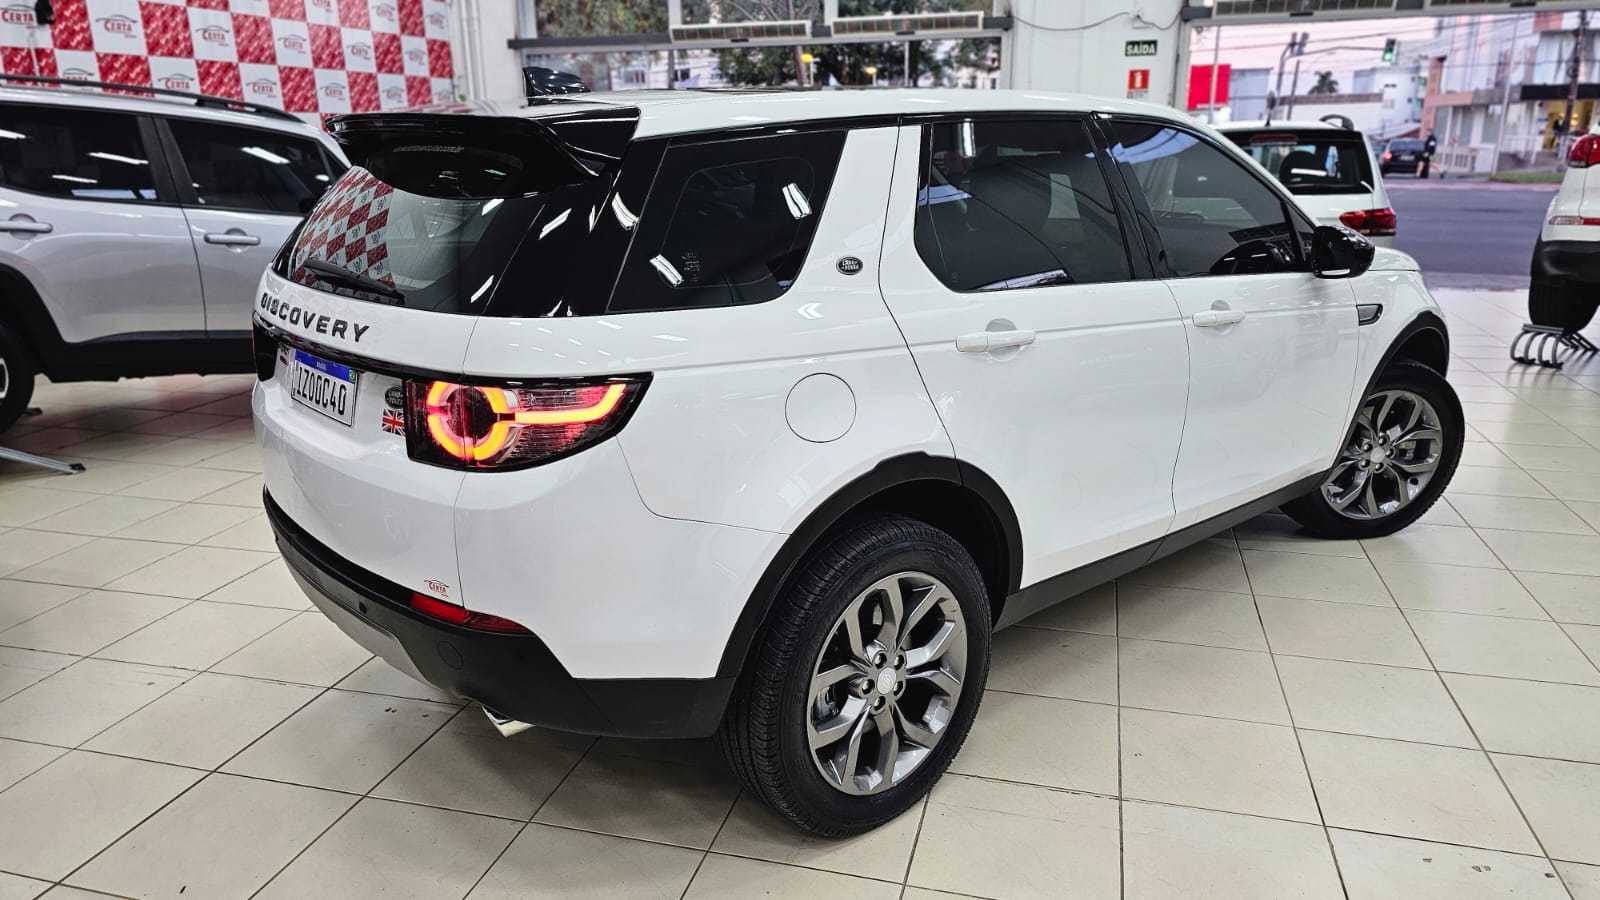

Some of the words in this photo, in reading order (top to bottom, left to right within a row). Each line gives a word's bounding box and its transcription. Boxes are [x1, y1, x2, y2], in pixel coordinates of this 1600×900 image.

[1, 9, 34, 23] CERTA
[104, 19, 133, 32] CERTA
[202, 29, 226, 41] CERTA
[1126, 42, 1155, 54] SAÍDA
[165, 79, 190, 90] CERTA
[260, 292, 370, 343] DISCOVERY
